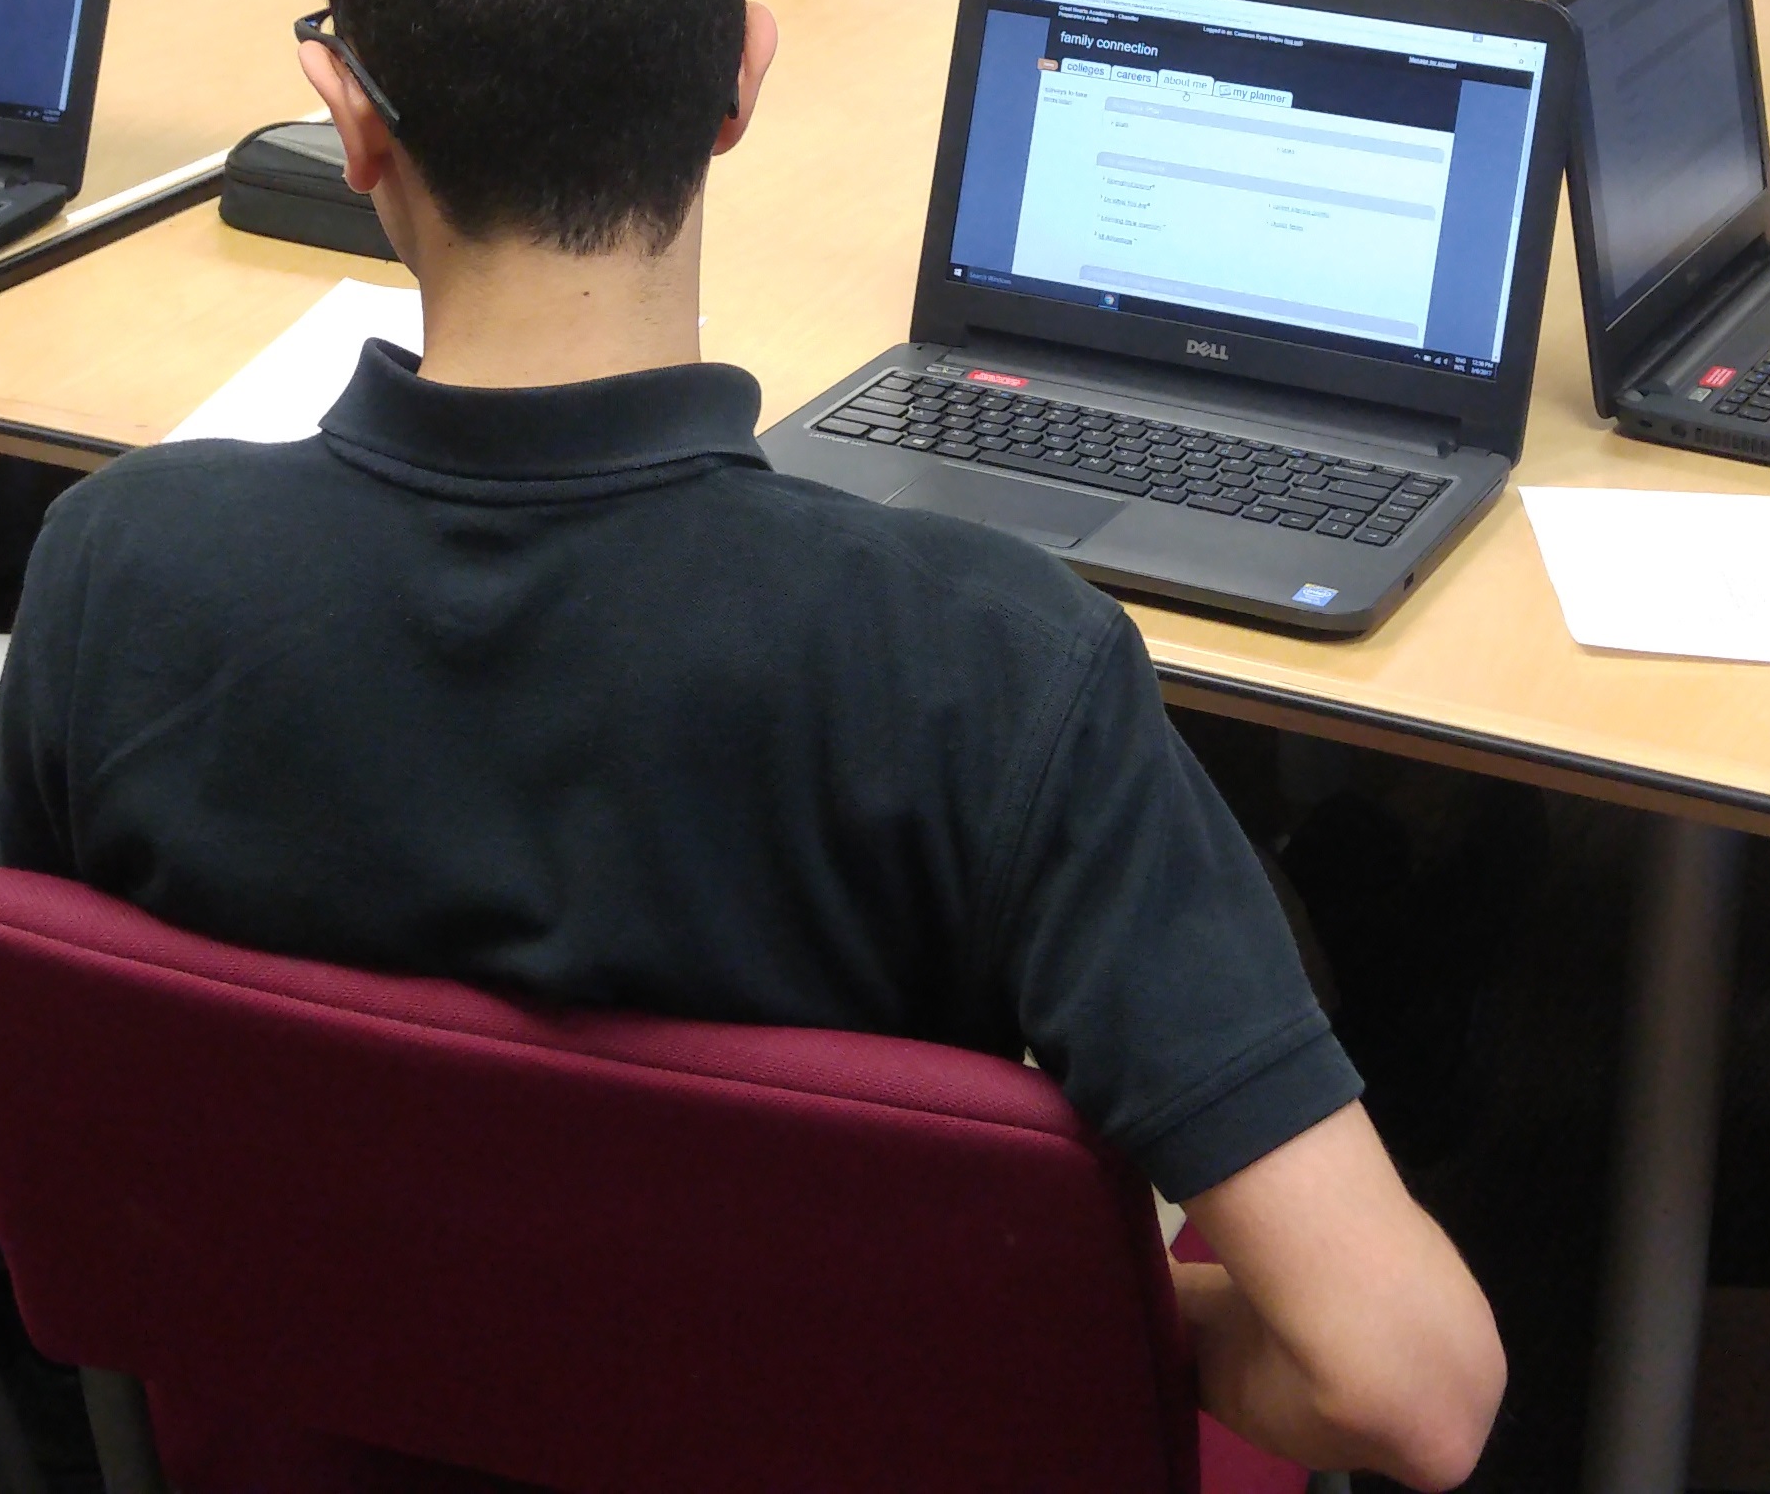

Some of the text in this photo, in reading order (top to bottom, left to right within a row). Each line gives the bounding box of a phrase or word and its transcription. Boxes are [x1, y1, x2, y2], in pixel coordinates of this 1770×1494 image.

[1060, 31, 1159, 57] family connection
[1067, 62, 1105, 77] colleges
[1116, 71, 1152, 83] careers
[1163, 74, 1208, 89] about me
[1233, 87, 1286, 104] my planner
[1186, 338, 1229, 361] DELL
